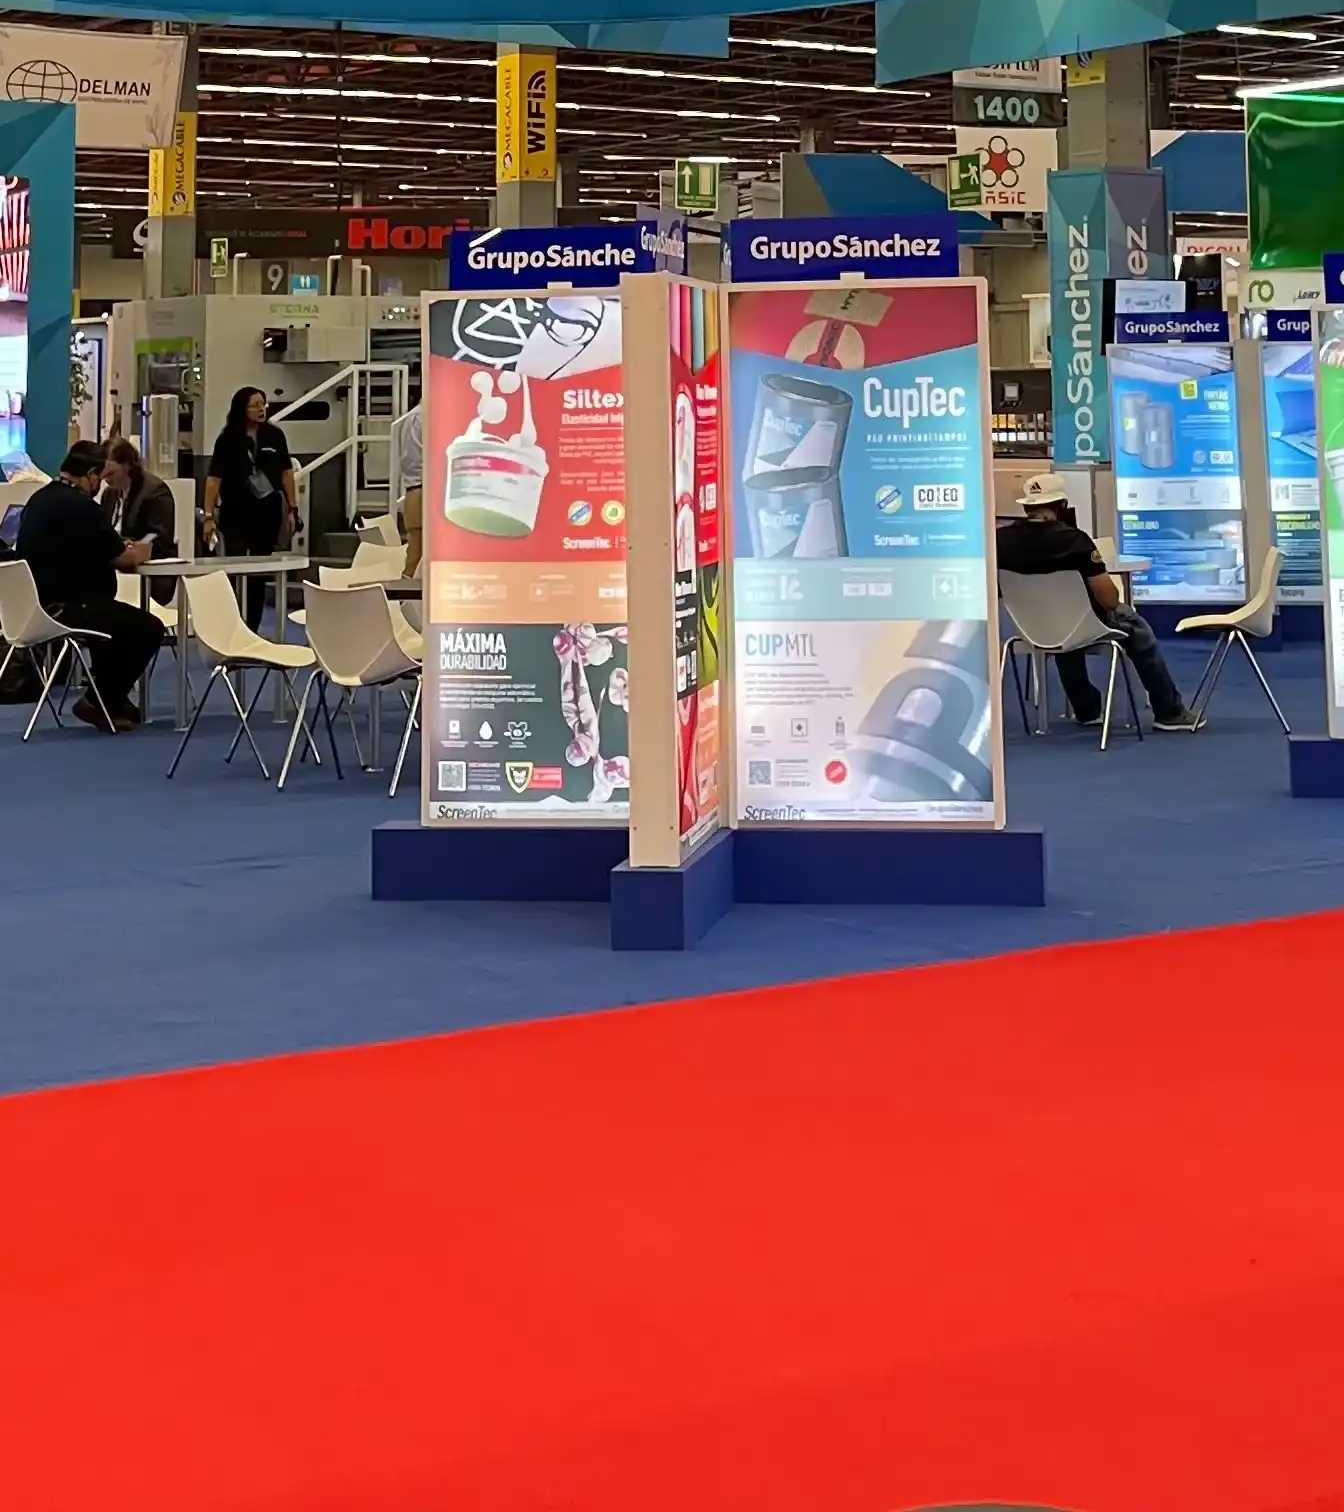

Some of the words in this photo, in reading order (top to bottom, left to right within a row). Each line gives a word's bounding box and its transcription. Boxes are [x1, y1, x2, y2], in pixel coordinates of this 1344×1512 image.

[79, 79, 151, 97] DELMAN
[504, 68, 512, 151] MEGACABLE
[973, 94, 1040, 124] 1400
[527, 92, 546, 155] WiFi
[467, 244, 636, 275] GrupoSánche
[750, 234, 941, 264] GrupoSánchez
[266, 264, 284, 291] 9
[269, 303, 320, 315] ETERNA
[1124, 320, 1220, 337] GrupoSánchez
[1276, 318, 1311, 334] Grup
[863, 376, 966, 429] CupTec
[440, 628, 507, 654] MÁXIMA
[440, 654, 507, 671] DURABILIDAD
[437, 804, 498, 820] ScreenTec
[744, 805, 807, 821] ScreenTec
